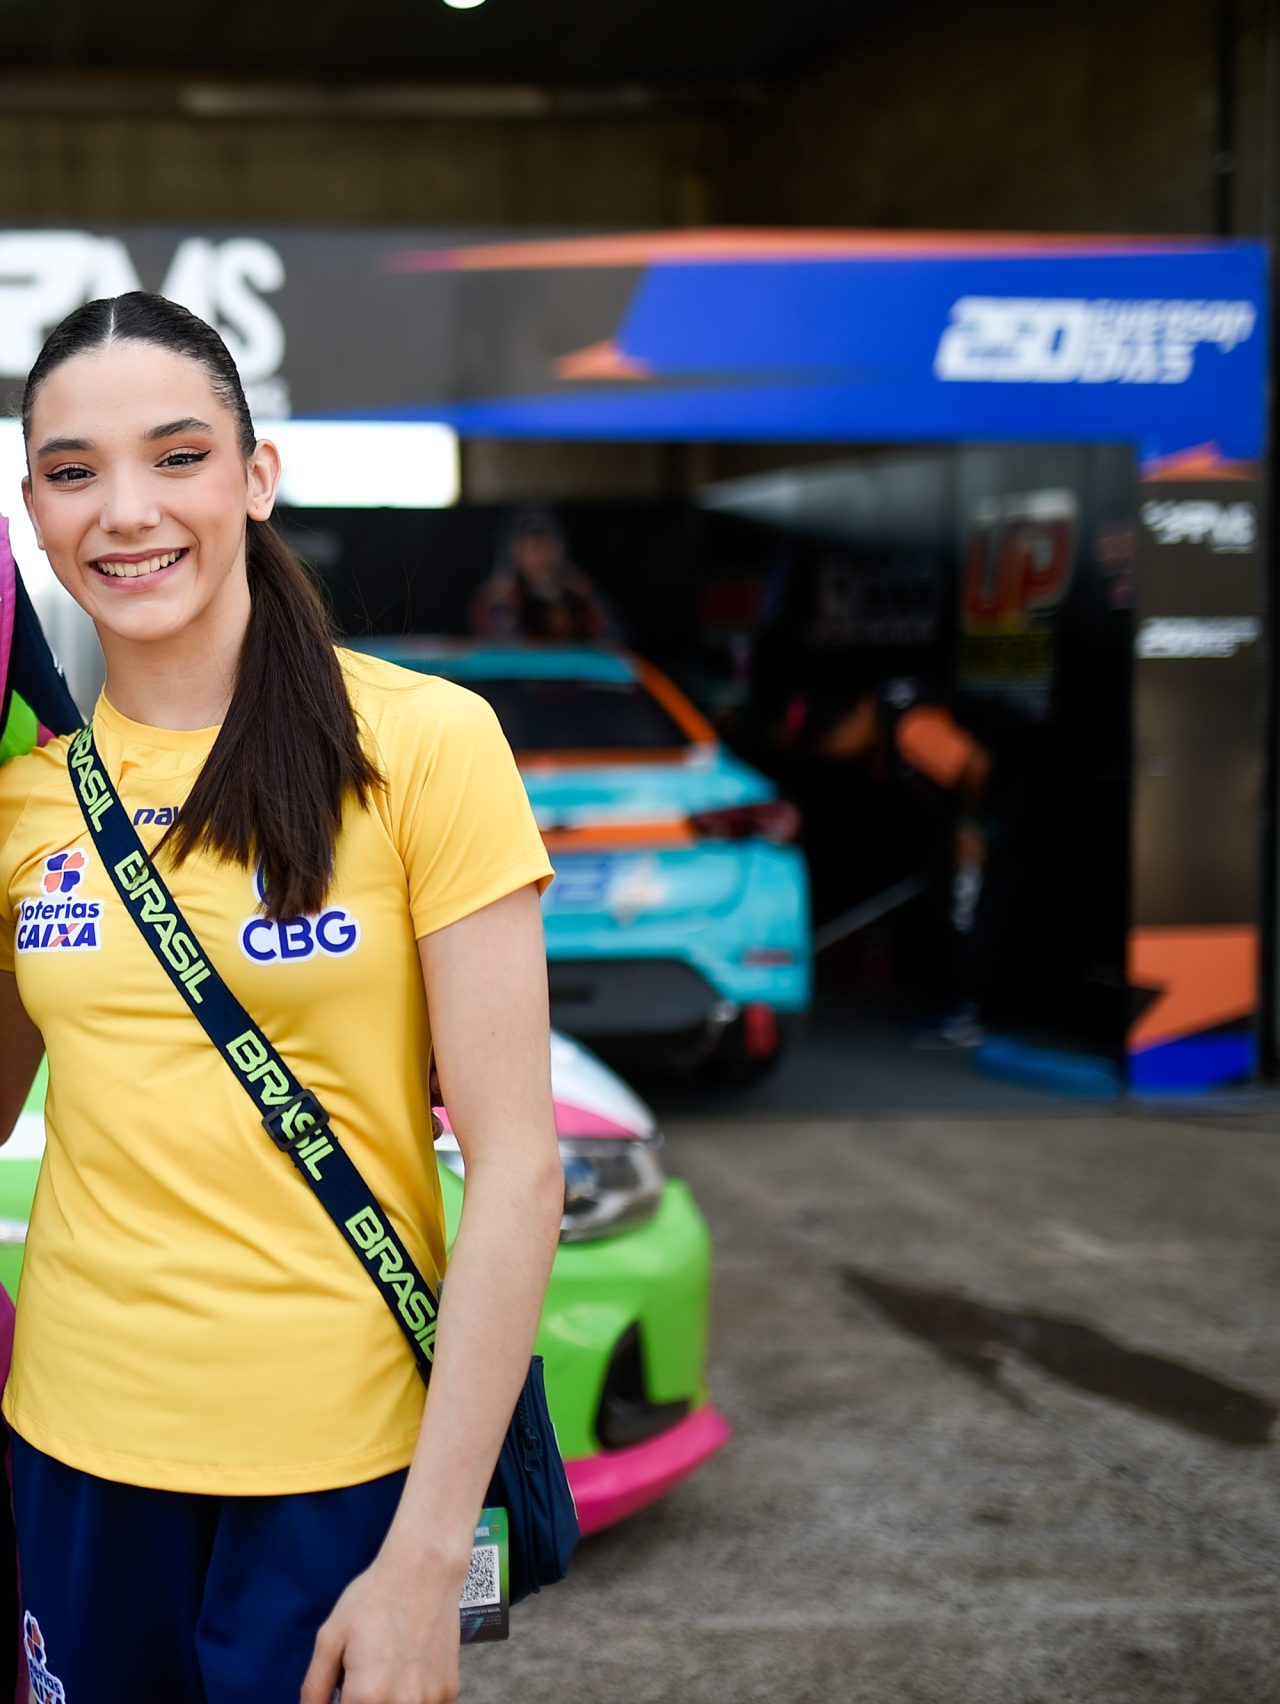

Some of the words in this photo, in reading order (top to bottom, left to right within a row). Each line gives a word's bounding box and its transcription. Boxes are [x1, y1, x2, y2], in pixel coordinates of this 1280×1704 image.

[17, 922, 97, 950] CAIXA
[21, 896, 100, 921] loterias
[114, 850, 211, 1004] BRASIL
[242, 910, 357, 961] CBG
[225, 1029, 334, 1182] BRASIL
[344, 1206, 438, 1363] BRASIL
